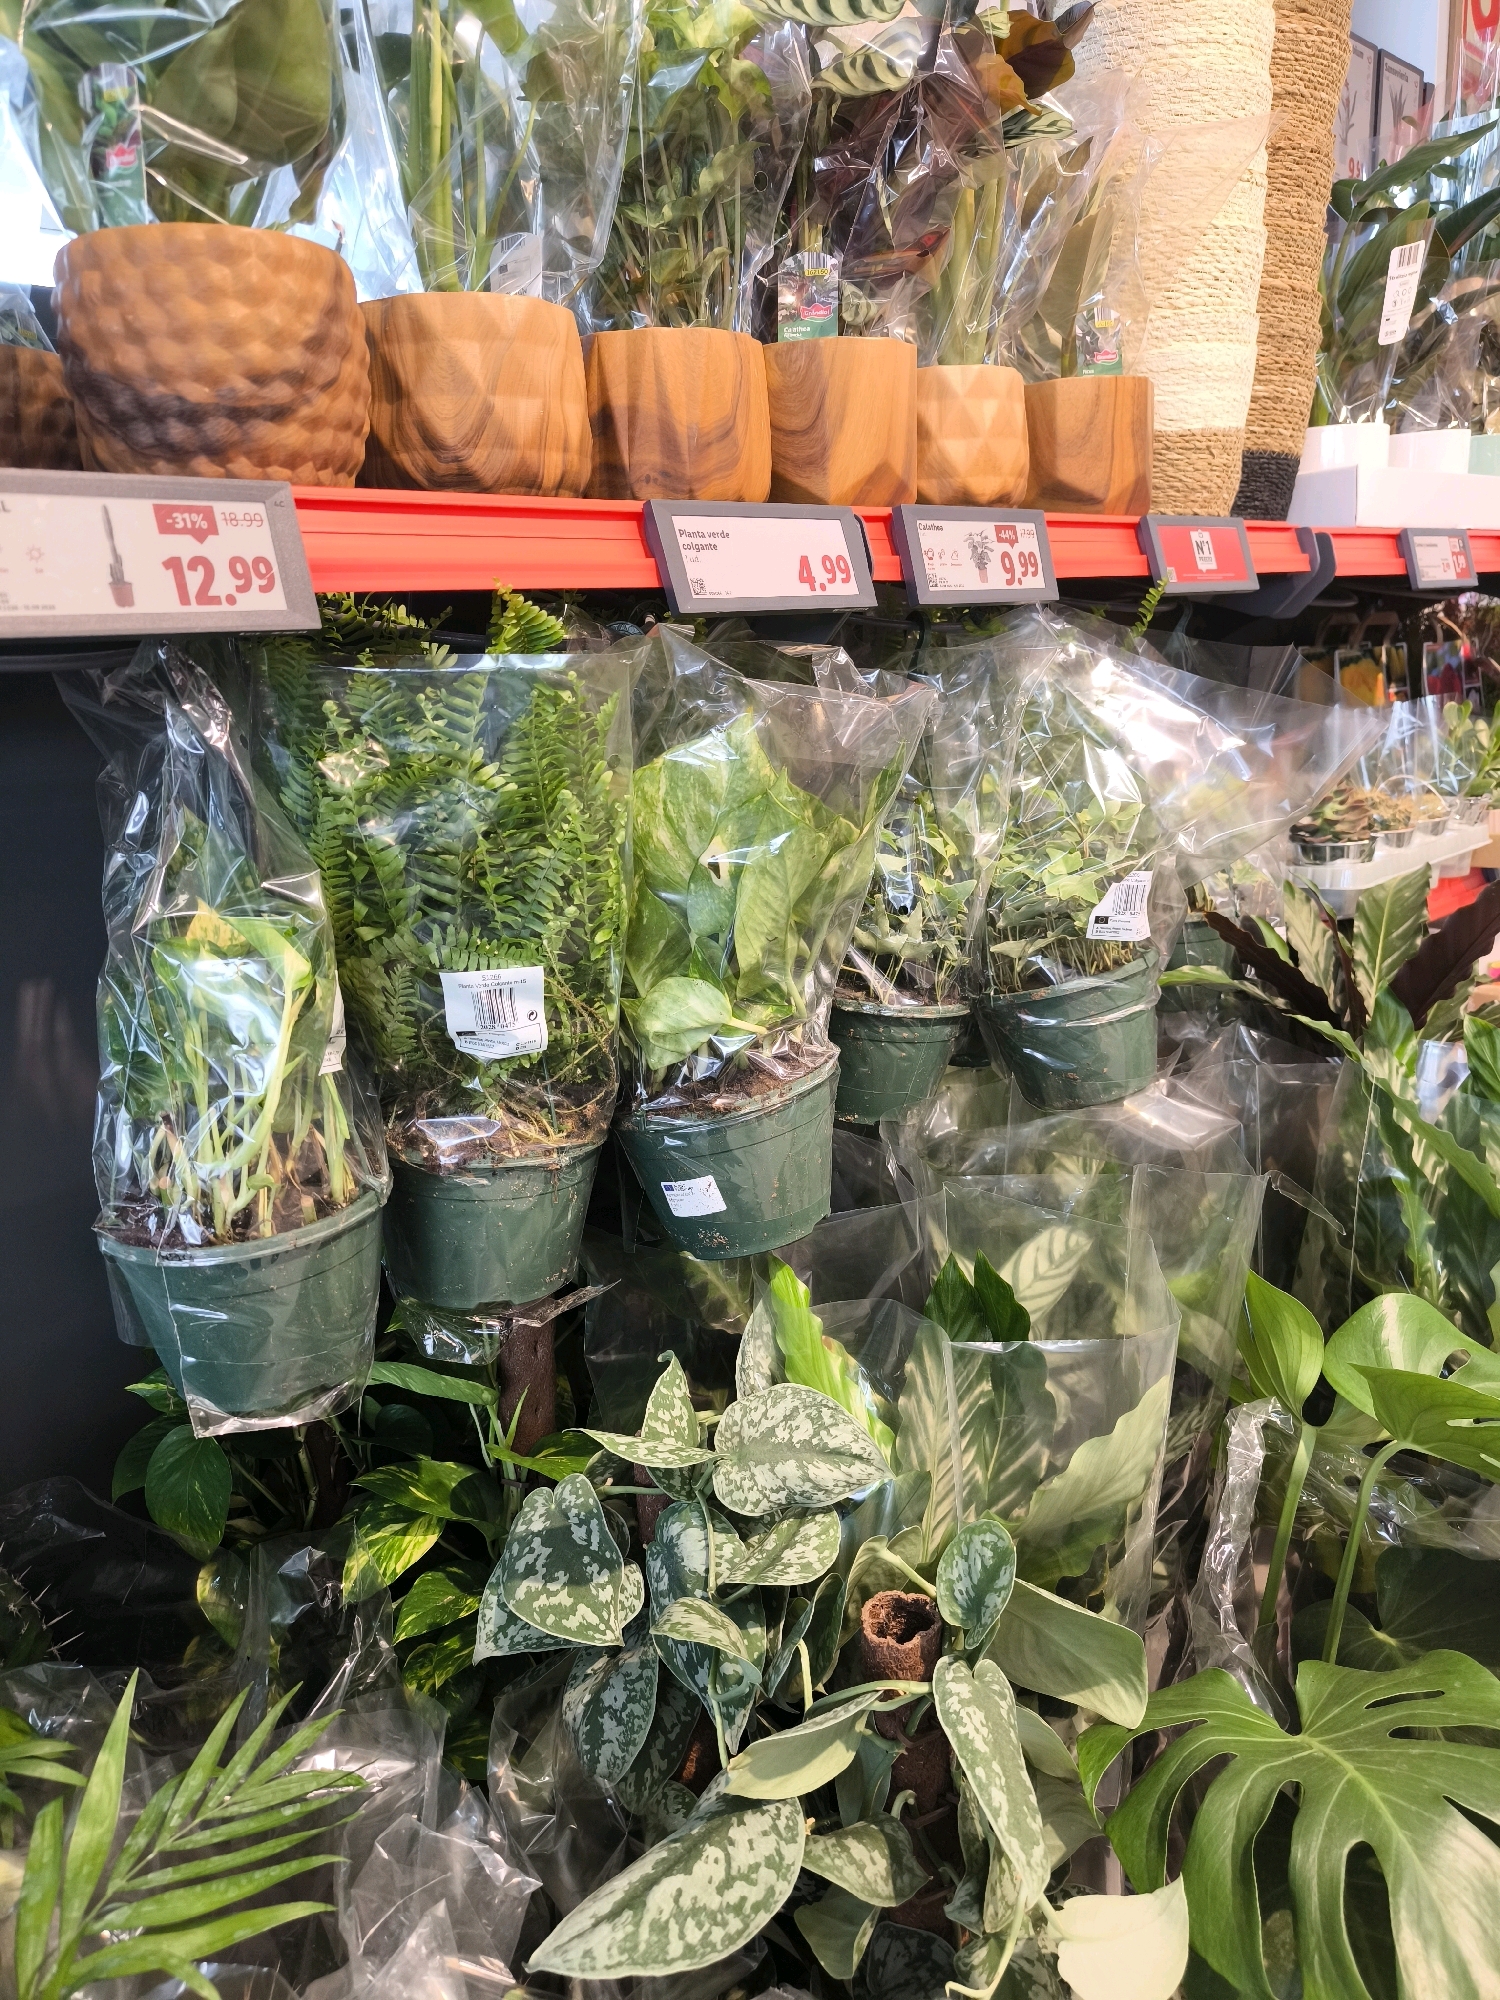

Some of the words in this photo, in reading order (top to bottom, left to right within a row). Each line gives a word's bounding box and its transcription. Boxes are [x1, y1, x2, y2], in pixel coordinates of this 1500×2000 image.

[165, 512, 208, 530] -31%
[220, 511, 264, 528] 18.99
[918, 522, 944, 531] Calathea
[677, 528, 707, 539] Planta
[707, 529, 730, 539] verde
[998, 529, 1016, 540] -44%
[682, 541, 718, 553] colgante
[798, 554, 852, 592] 4.99
[1000, 550, 1039, 587] 9.99
[162, 555, 276, 607] 12.99
